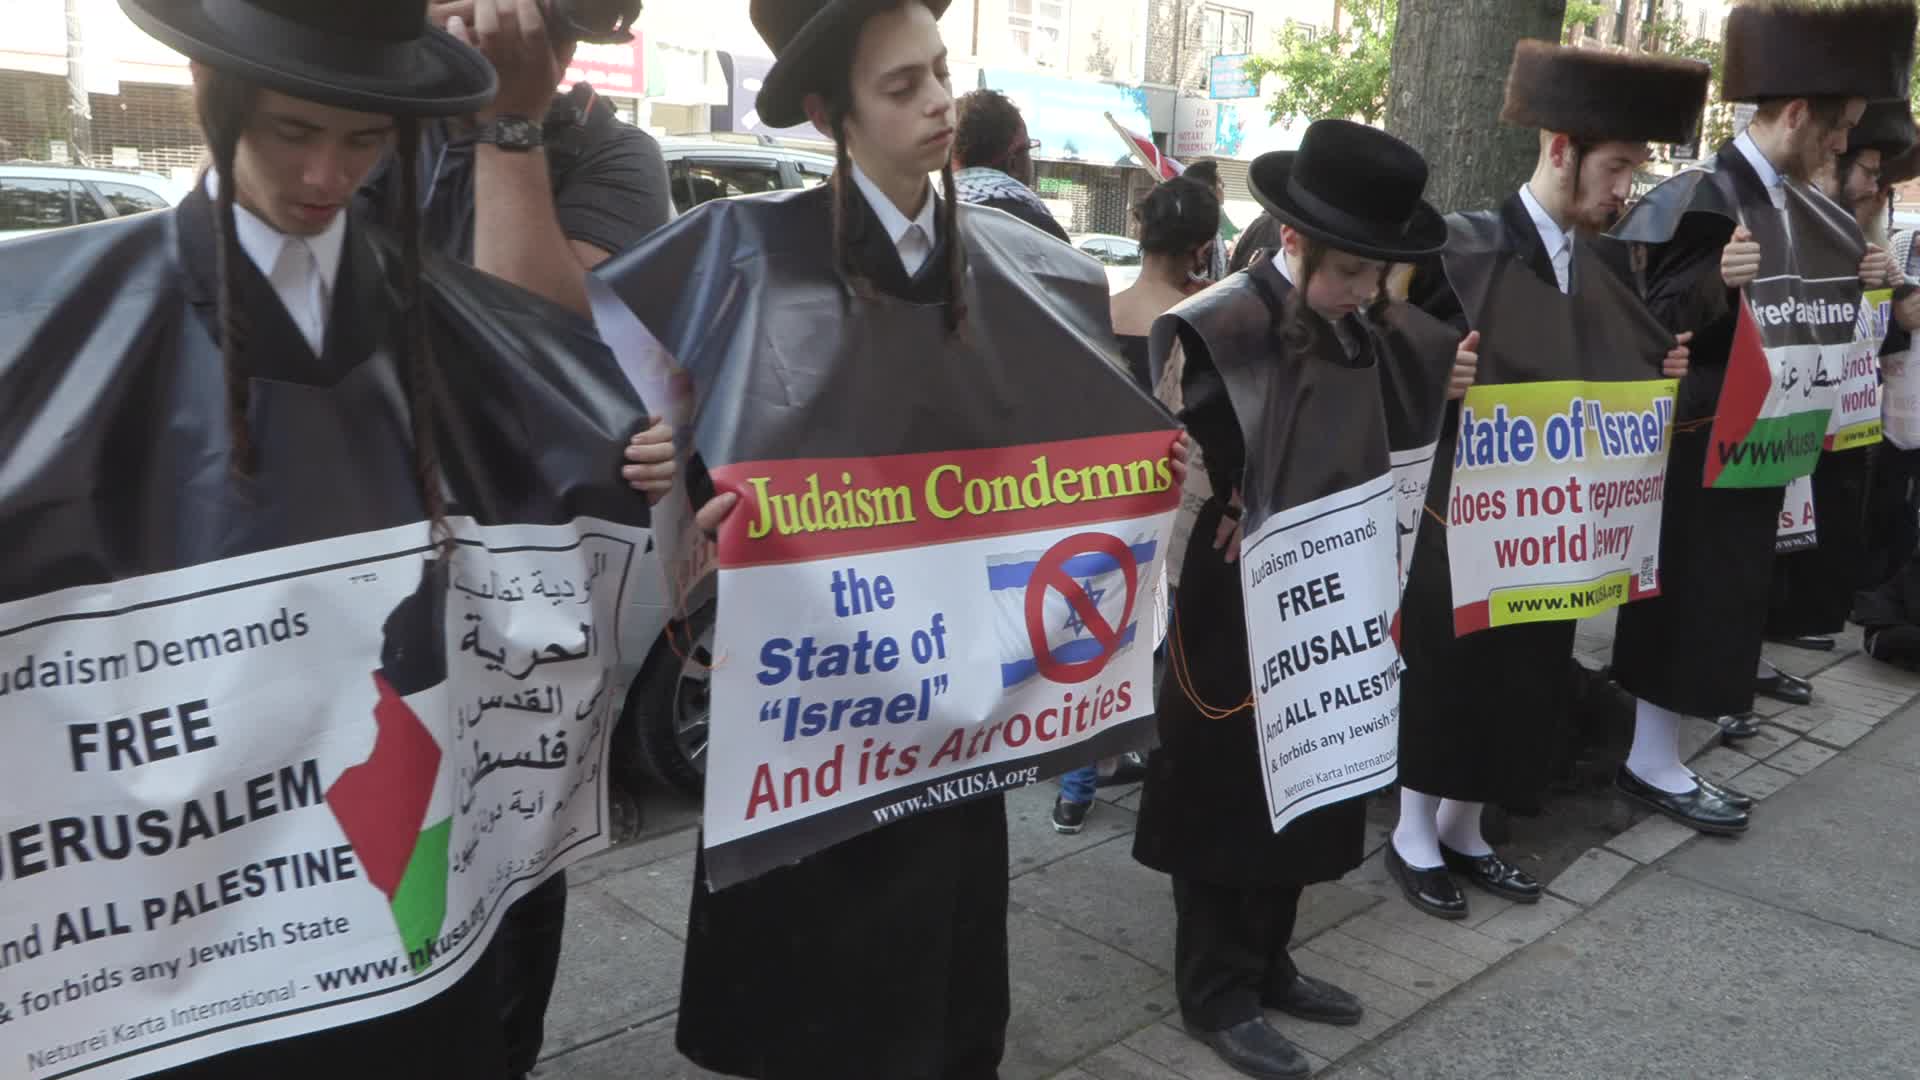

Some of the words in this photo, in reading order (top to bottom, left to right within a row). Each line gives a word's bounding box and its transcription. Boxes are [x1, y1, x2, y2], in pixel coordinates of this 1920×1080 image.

[1850, 351, 1873, 379] not
[1841, 382, 1877, 413] world
[1546, 398, 1585, 461] of
[1587, 398, 1673, 457] "Israel"
[746, 471, 917, 540] Judaism
[924, 455, 1174, 519] Condemns
[1451, 485, 1507, 526] does
[1516, 476, 1583, 518] not
[1589, 468, 1665, 518] represent
[1250, 548, 1298, 588] Judaism
[1301, 518, 1378, 560] Demands
[1494, 523, 1588, 569] world
[830, 567, 895, 618] the
[1276, 571, 1345, 622] FREE
[0, 650, 128, 696] udaism
[134, 607, 309, 674] Demands
[756, 629, 900, 686] State
[911, 612, 948, 665] of
[68, 698, 218, 772] FREE
[743, 744, 845, 821] And
[856, 739, 919, 786] its
[927, 680, 1133, 771] Atrocities
[1264, 715, 1283, 744] And
[1283, 700, 1318, 732] ALL
[1270, 758, 1279, 773] &
[1279, 736, 1318, 769] forbids
[1320, 728, 1345, 749] any
[1349, 713, 1390, 739] Jewish
[872, 764, 1040, 824] www.NKUSA.org
[1284, 774, 1315, 800] Neturei
[1315, 767, 1343, 792] Karta
[0, 758, 324, 883] ERUSALEM
[0, 922, 42, 968] nd
[53, 901, 132, 952] ALL
[142, 843, 357, 931] PALESTINE
[21, 964, 124, 1018] forbids
[131, 955, 181, 985] any
[188, 925, 276, 970] Jewish
[282, 912, 350, 945] State
[27, 1029, 107, 1072] Neturei
[112, 1013, 167, 1045] Karta
[172, 979, 296, 1028] International
